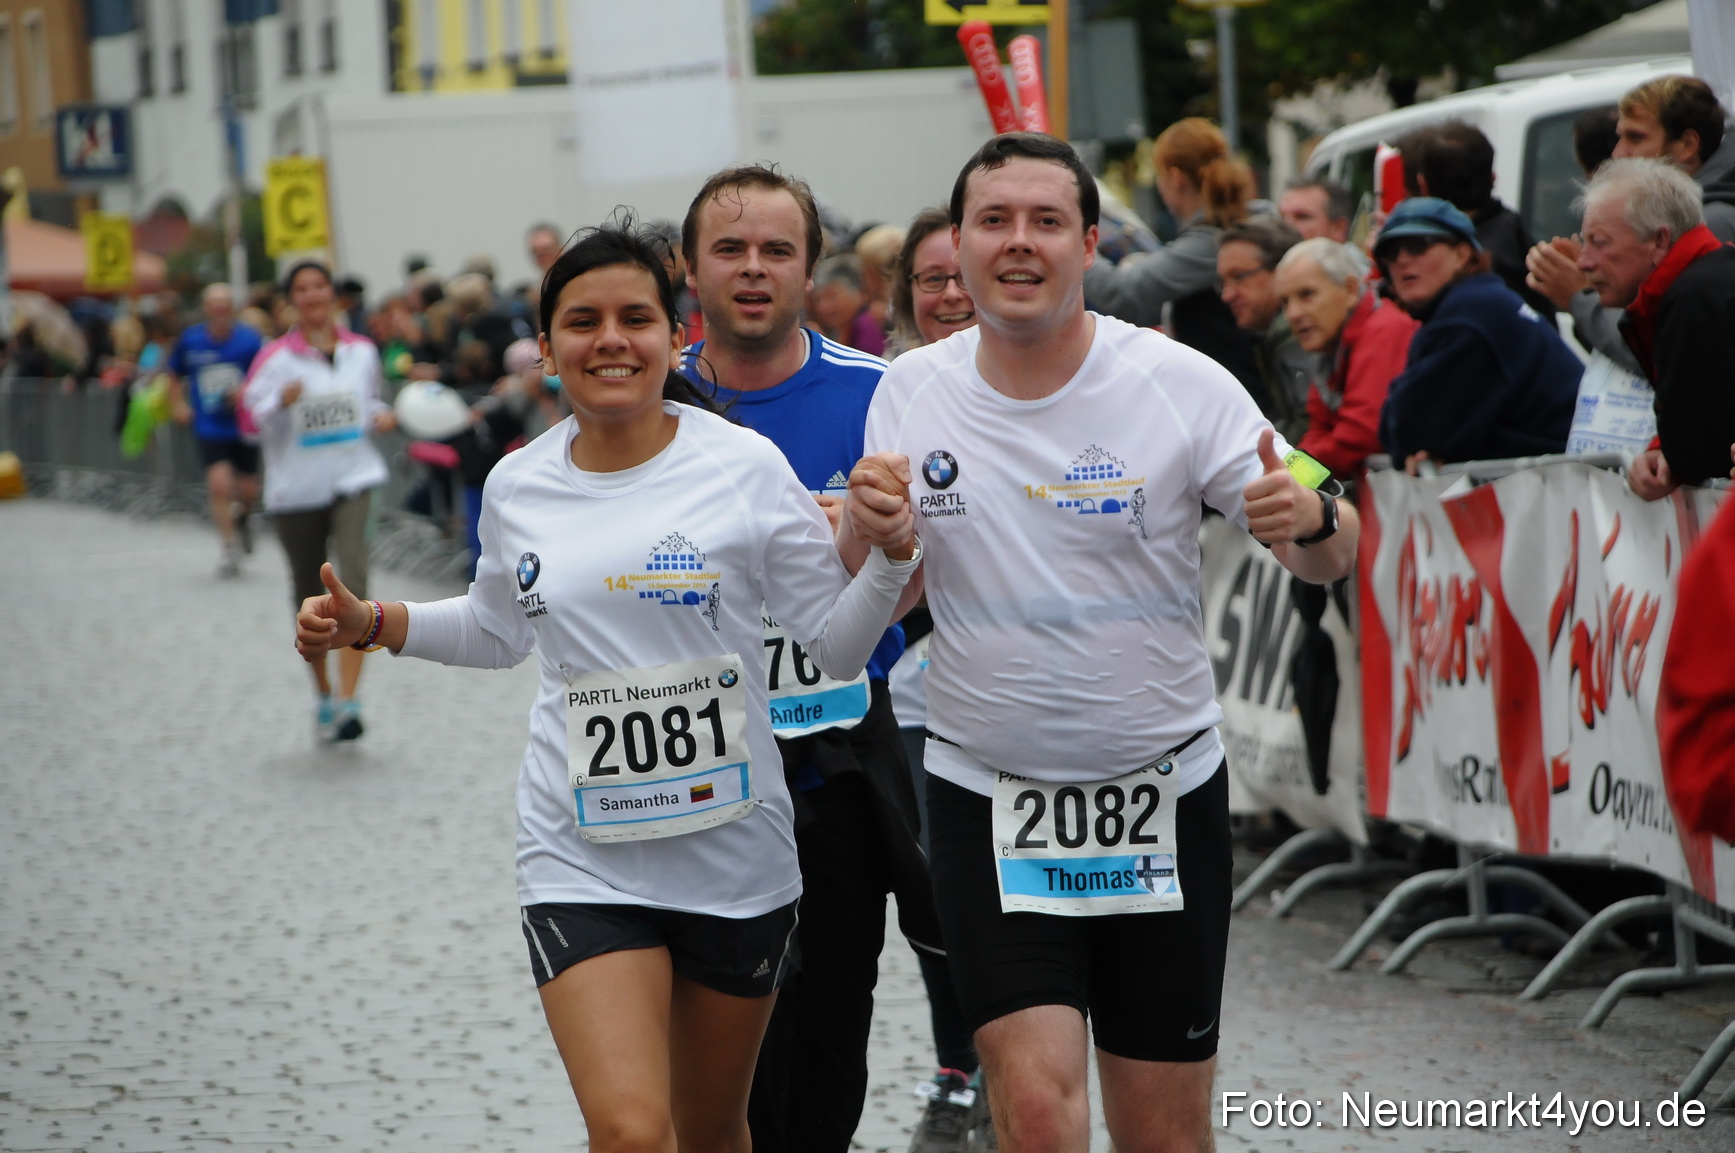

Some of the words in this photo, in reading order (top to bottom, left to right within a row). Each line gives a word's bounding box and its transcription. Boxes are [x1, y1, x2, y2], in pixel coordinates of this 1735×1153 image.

[278, 184, 313, 233] C
[924, 451, 955, 465] BMW
[826, 480, 848, 488] adida
[1023, 484, 1053, 500] 14.
[1048, 480, 1101, 492] Neumarkter
[1103, 476, 1146, 488] Stadtlauf
[920, 492, 966, 509] PARTL
[921, 506, 967, 518] Neumarkt
[603, 574, 634, 592] 14.
[628, 572, 681, 582] Neumarkter
[684, 571, 721, 580] Stadtlauf
[525, 606, 548, 618] umarkt
[764, 636, 823, 691] 76
[569, 688, 623, 708] PARTL
[625, 676, 711, 702] Neumarkt
[770, 703, 823, 724] Andre
[585, 697, 727, 777] 2081
[599, 789, 680, 811] Samantha
[1013, 783, 1160, 849] 2082
[1043, 868, 1135, 891] Thomas
